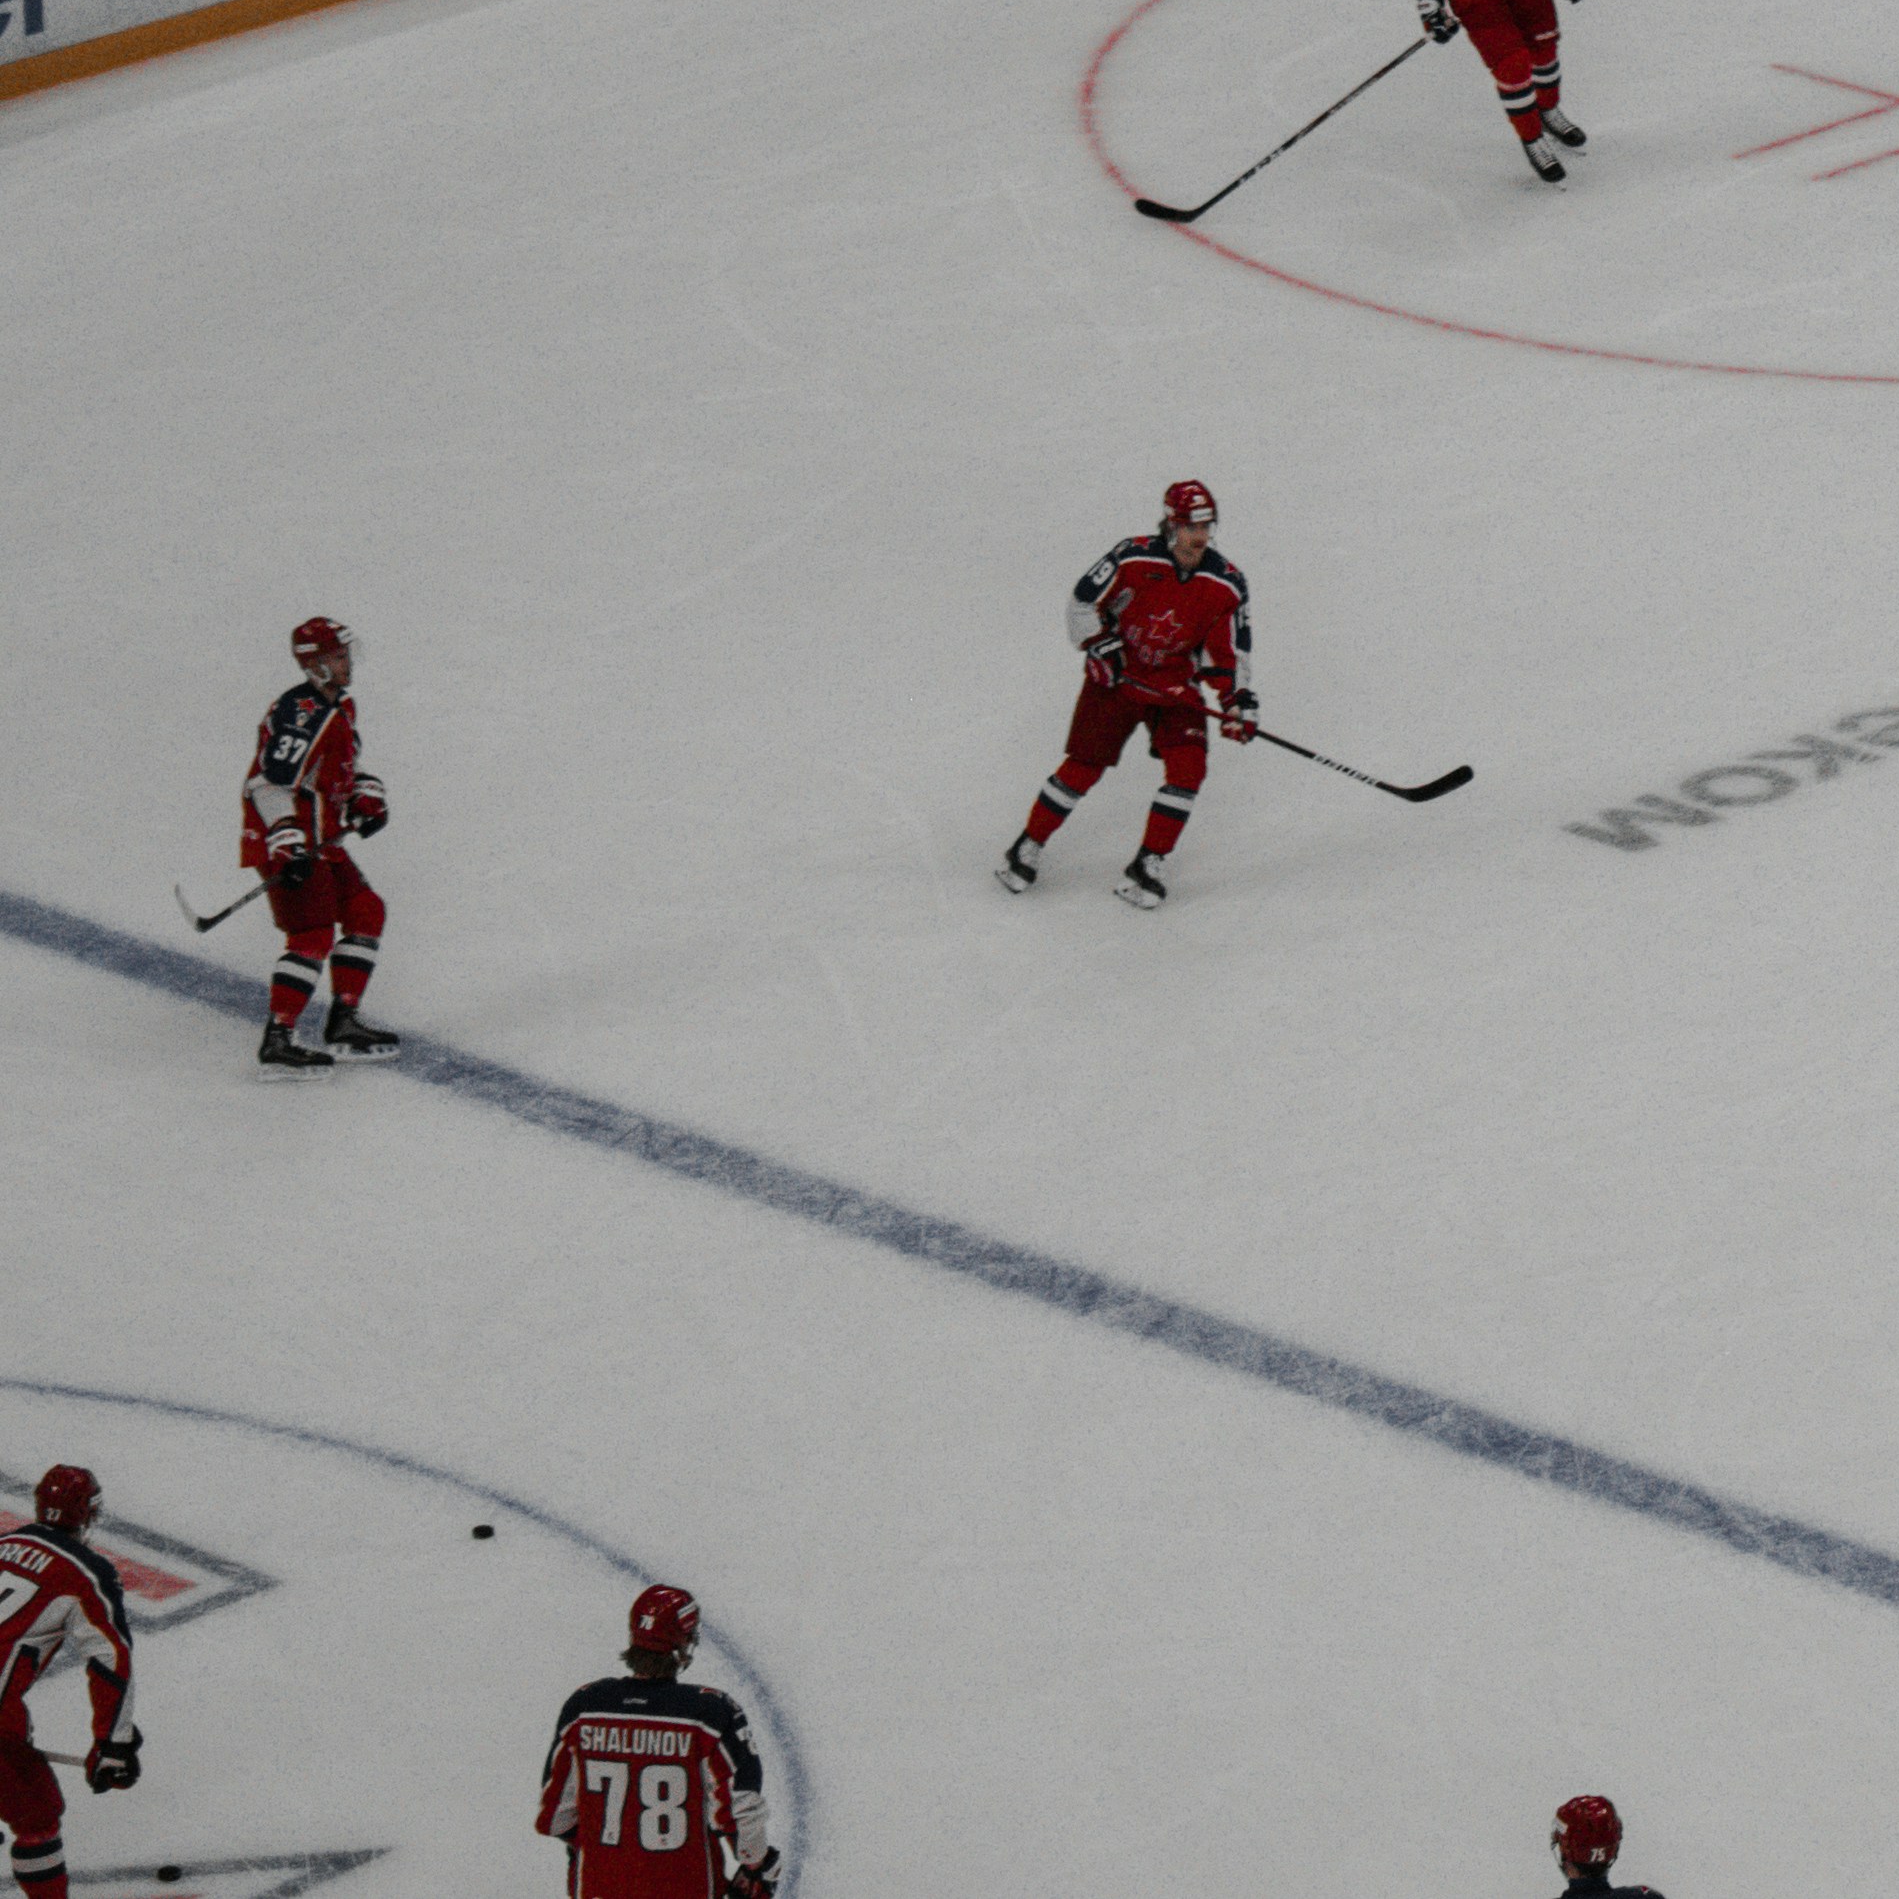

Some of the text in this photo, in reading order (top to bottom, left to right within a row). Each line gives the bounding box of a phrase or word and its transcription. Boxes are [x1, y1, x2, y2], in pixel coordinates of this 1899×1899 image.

[273, 735, 309, 765] 37
[579, 1724, 693, 1758] SHALUNOV
[584, 1758, 690, 1853] 78
[1588, 1846, 1607, 1863] 75
